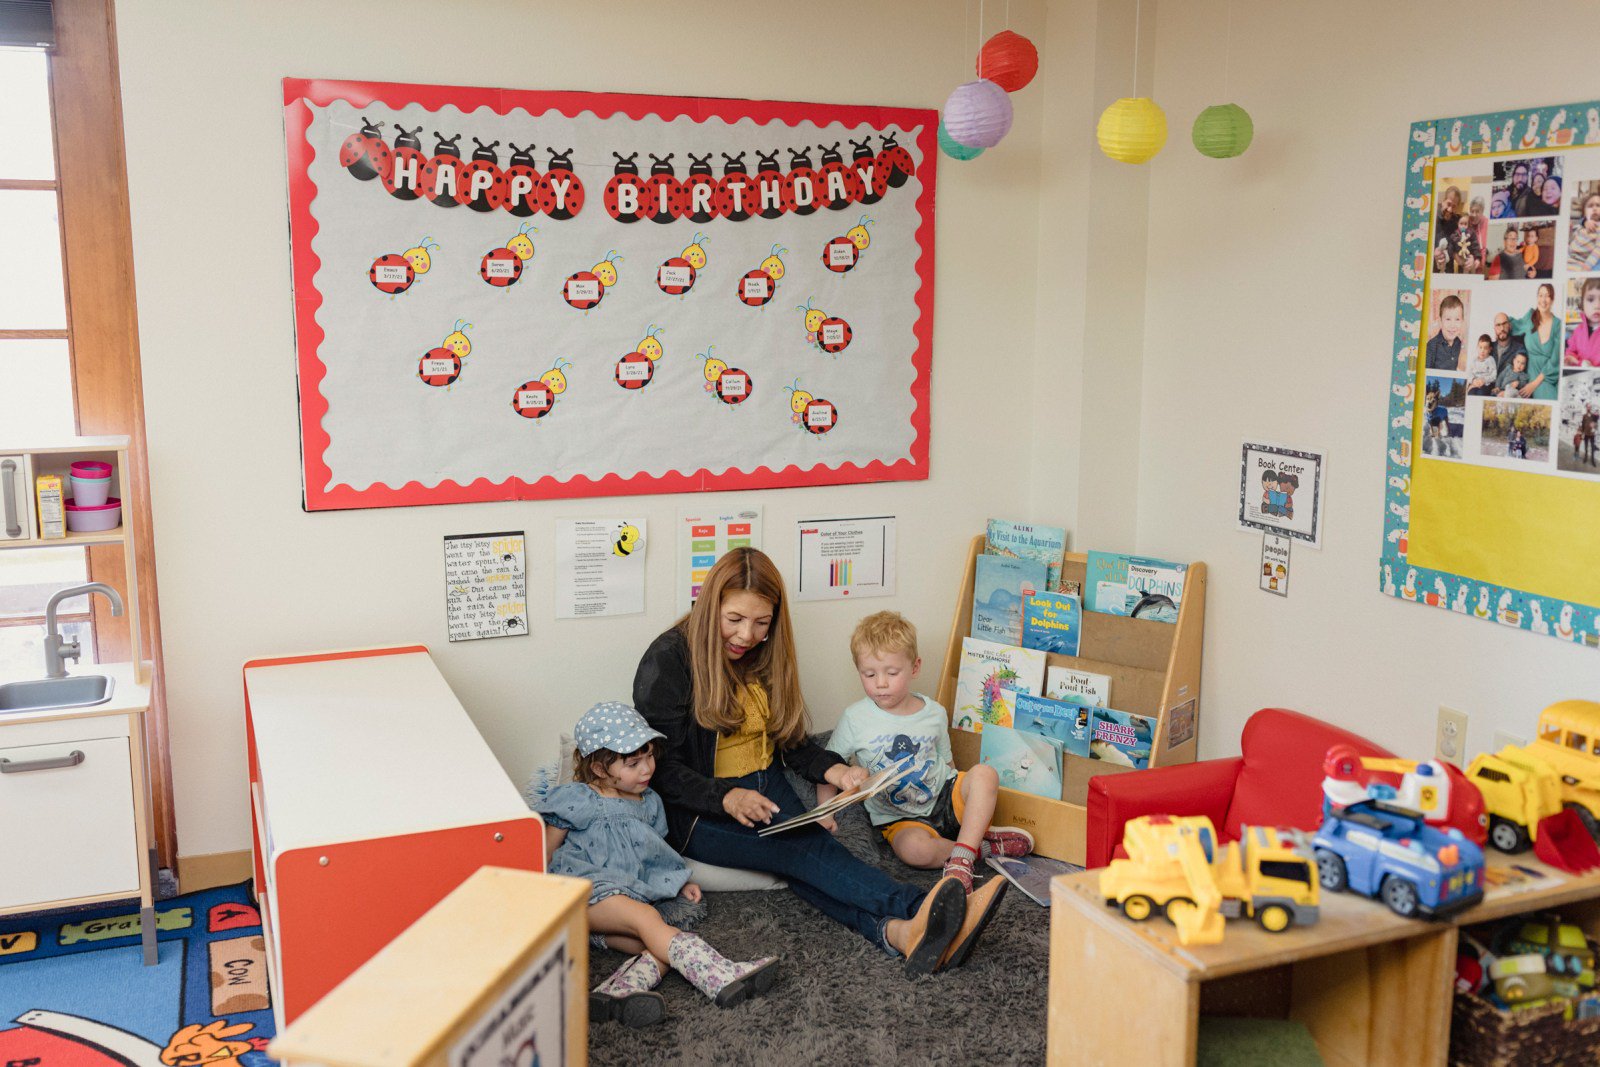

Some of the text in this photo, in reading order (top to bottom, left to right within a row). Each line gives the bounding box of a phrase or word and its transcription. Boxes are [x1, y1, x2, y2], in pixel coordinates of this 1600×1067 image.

[394, 157, 877, 214] HAPPY BIRTHDAY
[1258, 458, 1304, 474] Book Center
[997, 530, 1009, 541] Visit
[1012, 534, 1017, 542] to
[1019, 534, 1028, 544] the
[1029, 536, 1062, 549] Aquarium
[446, 541, 458, 549] The
[492, 536, 522, 556] spider
[1265, 545, 1287, 556] people
[1131, 566, 1157, 575] Discovery
[447, 576, 470, 585] washed
[474, 575, 485, 583] the
[448, 604, 461, 612] the
[497, 602, 526, 618] spider
[1030, 597, 1071, 611] Look Out
[448, 612, 459, 620] the
[978, 614, 992, 622] Dear
[1044, 608, 1057, 618] for
[489, 618, 501, 626] the
[1031, 616, 1069, 631] Dolphins
[977, 624, 1005, 634] Little Fish
[450, 631, 471, 641] spout
[986, 655, 1010, 663] SEAHORSE
[1060, 681, 1096, 695] Pout Fish
[1016, 698, 1033, 712] Out
[1054, 704, 1078, 720] Deep
[1099, 721, 1135, 736] SHARK
[1095, 730, 1137, 747] FRENZY
[1013, 815, 1036, 826] KAPLAN
